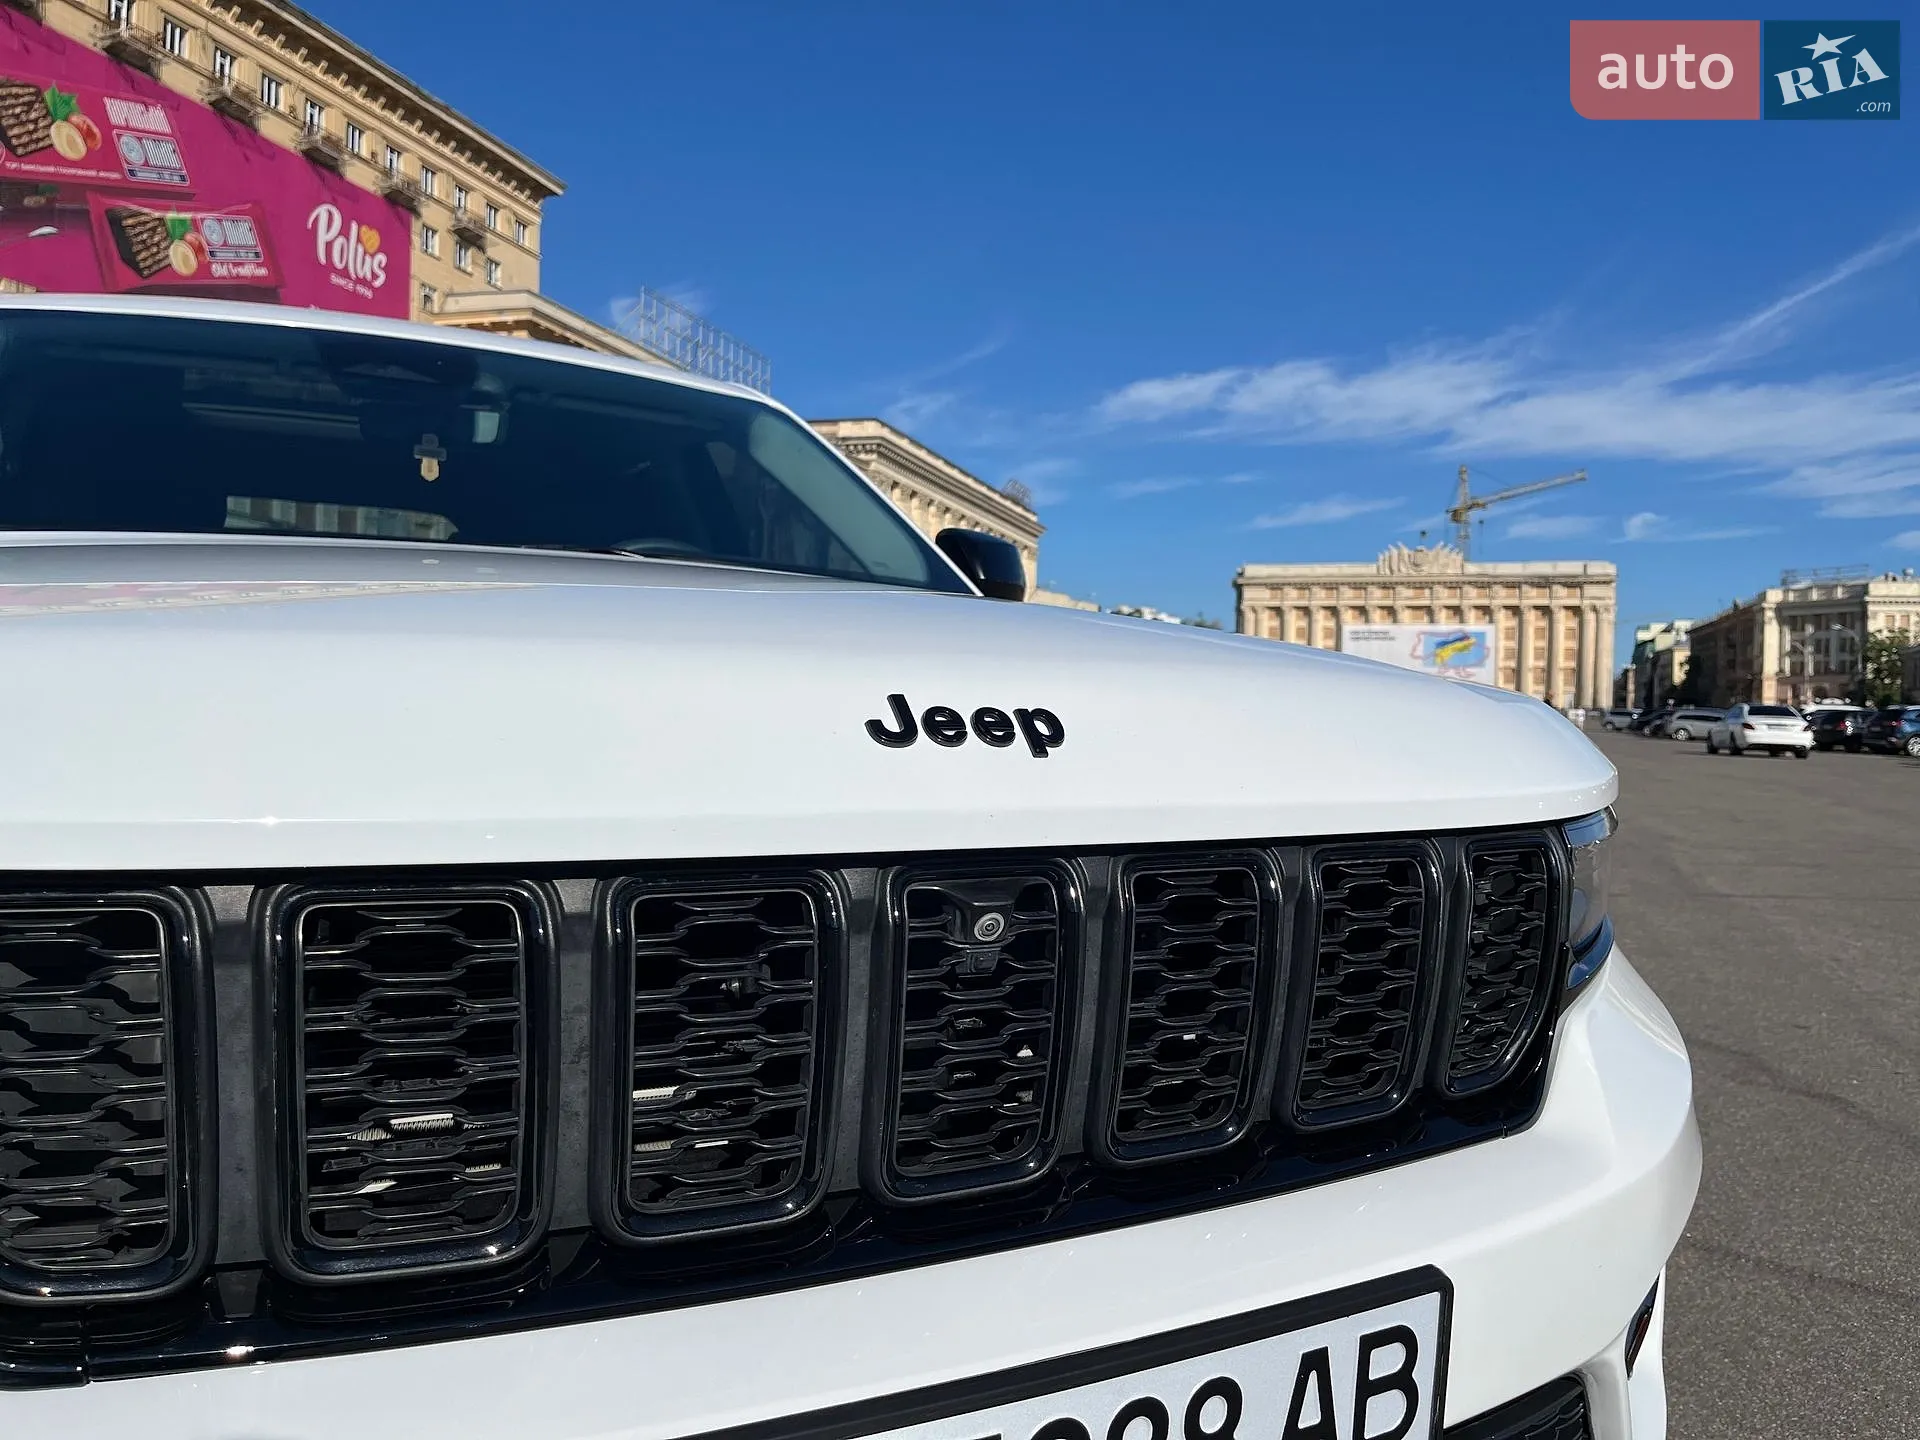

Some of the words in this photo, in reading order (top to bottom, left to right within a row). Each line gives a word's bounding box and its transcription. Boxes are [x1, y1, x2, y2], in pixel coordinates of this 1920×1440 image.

[306, 203, 388, 288] Polus
[864, 694, 1065, 758] Jeep
[1282, 1324, 1420, 1440] AB
